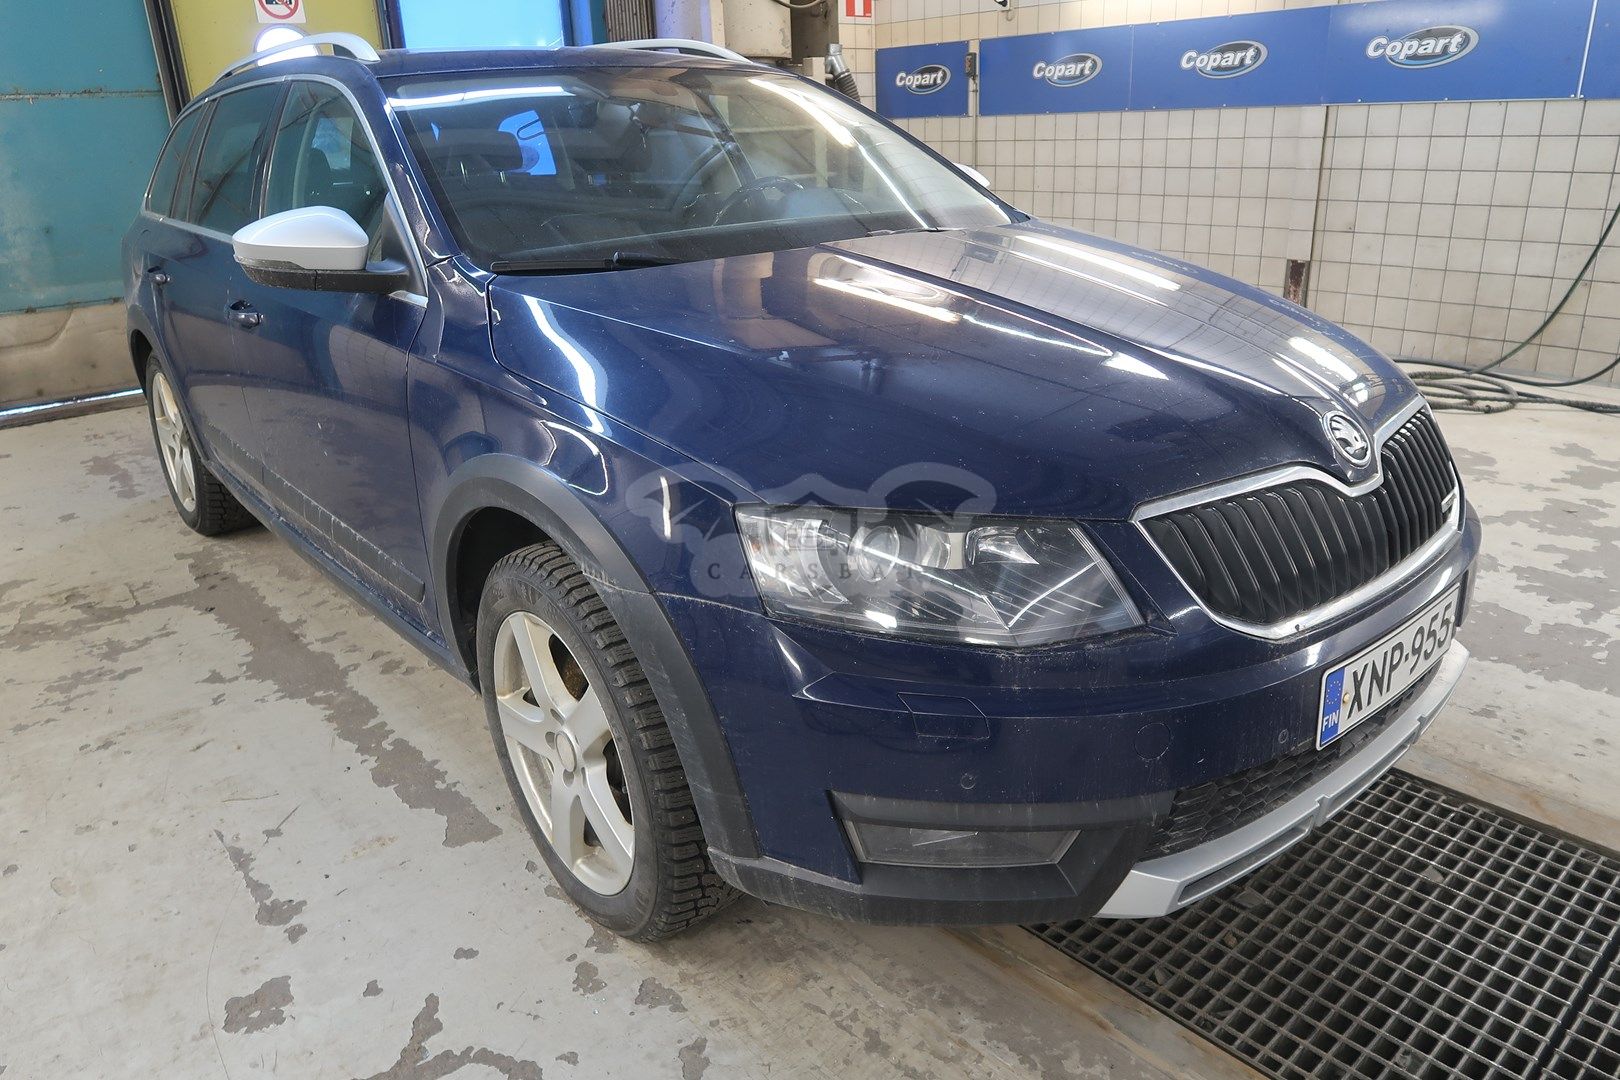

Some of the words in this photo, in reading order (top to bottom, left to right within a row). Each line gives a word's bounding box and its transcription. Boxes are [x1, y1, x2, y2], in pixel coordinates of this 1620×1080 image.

[1367, 32, 1465, 60] Copart
[1181, 46, 1257, 69] Copart
[896, 68, 944, 88] Copart
[1033, 59, 1094, 80] Copart
[1347, 601, 1453, 719] XNP-955
[1322, 709, 1340, 731] FIN
